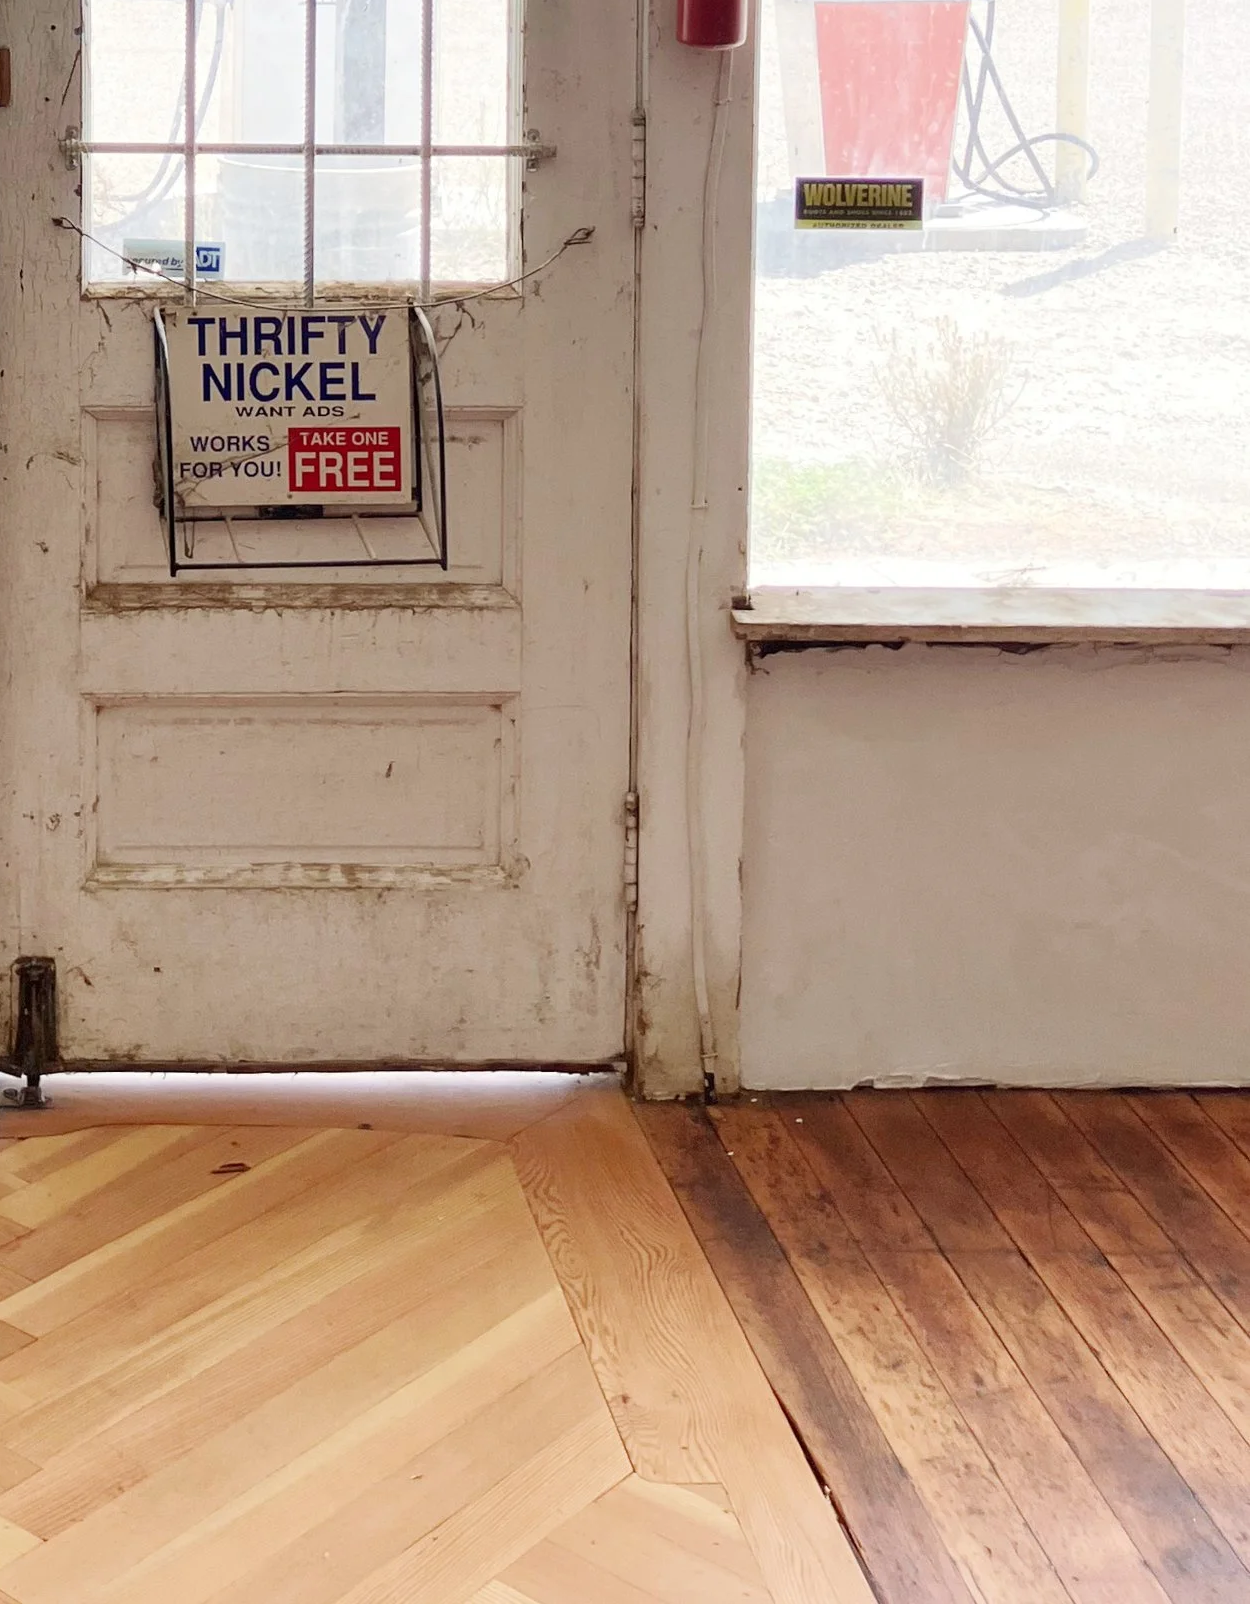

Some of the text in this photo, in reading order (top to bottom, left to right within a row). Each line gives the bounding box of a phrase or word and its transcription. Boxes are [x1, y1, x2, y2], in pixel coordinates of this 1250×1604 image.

[803, 183, 913, 207] WOLVERINE
[187, 315, 387, 356] THRIFTY
[202, 361, 376, 402] NICKEL
[235, 406, 345, 417] WANT ADS
[190, 435, 271, 452] WORKS
[299, 431, 389, 446] TAKE ONE
[180, 461, 282, 478] FOR YOU!
[295, 451, 397, 488] FREE
